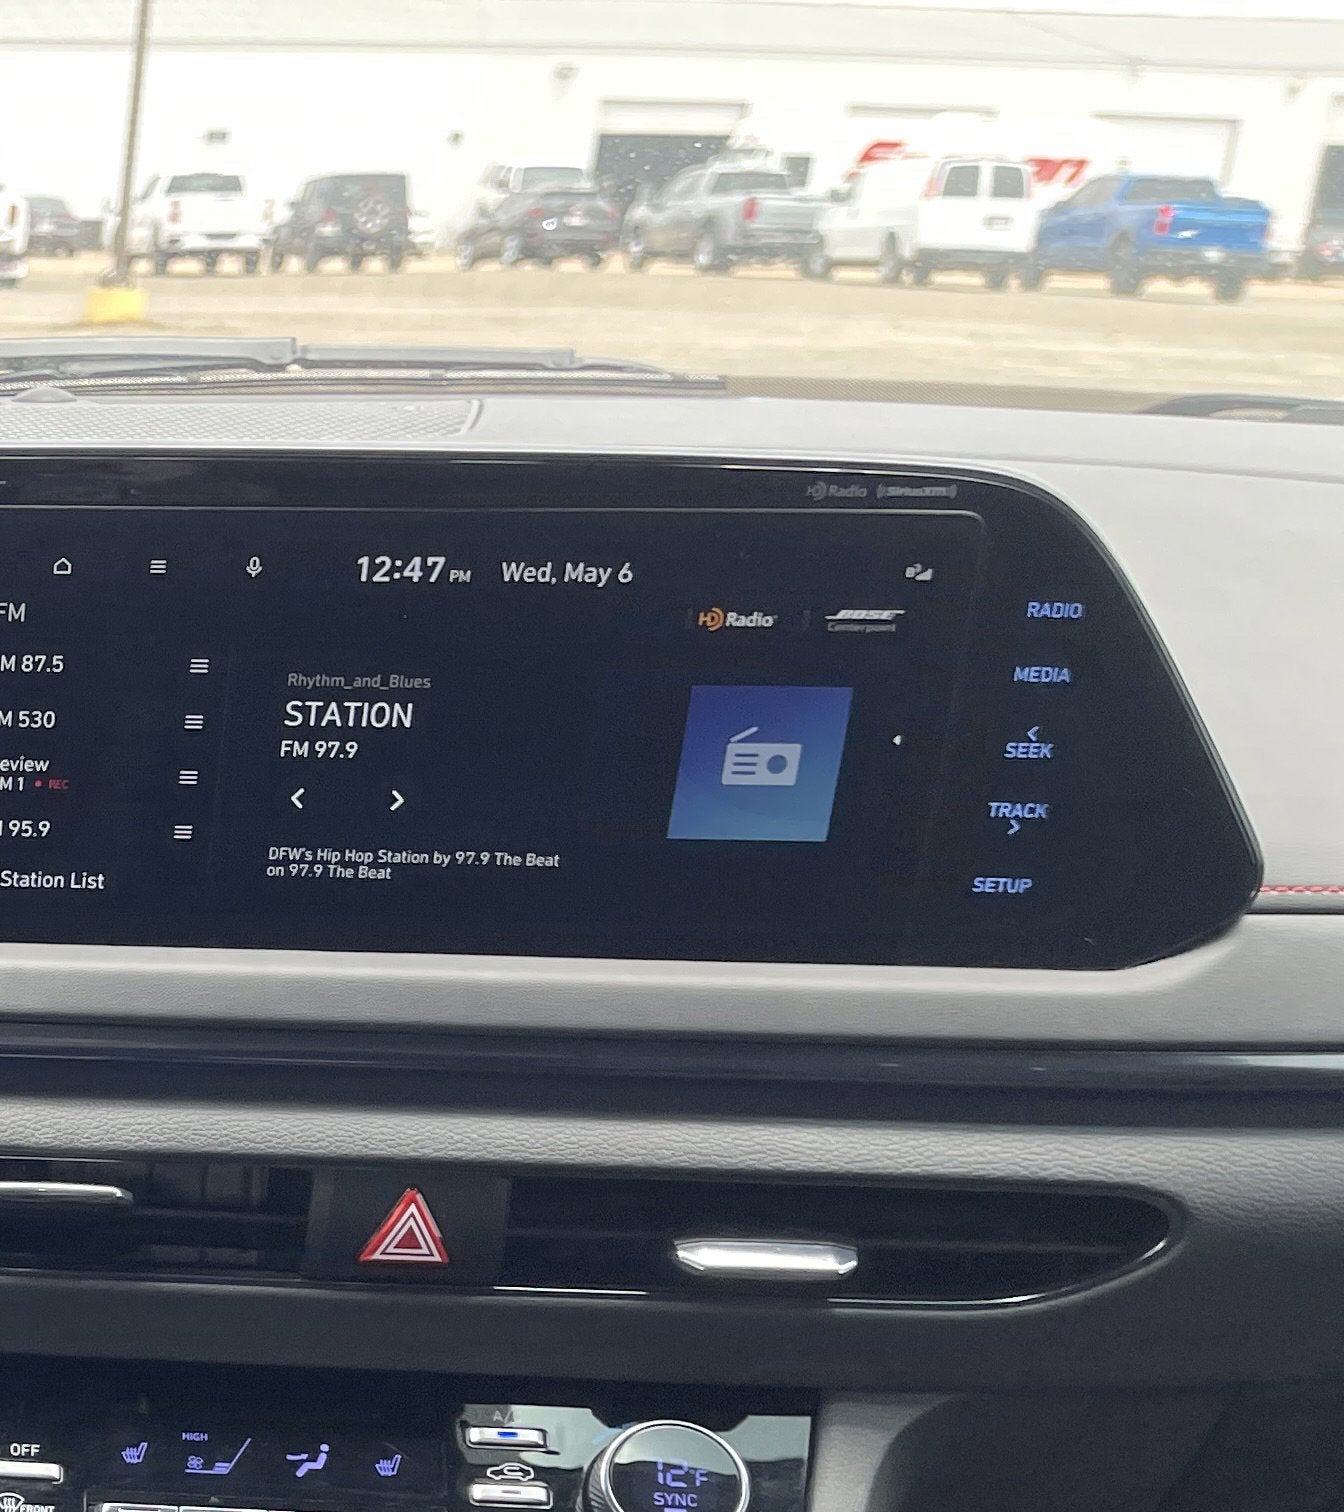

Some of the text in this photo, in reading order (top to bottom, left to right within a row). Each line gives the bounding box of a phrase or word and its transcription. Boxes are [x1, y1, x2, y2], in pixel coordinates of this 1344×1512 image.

[356, 556, 472, 584] 12:47 PM
[501, 561, 634, 588] Wed, May 6
[824, 609, 906, 621] BOSE
[1026, 602, 1083, 619] RADIO
[725, 611, 774, 628] Radio
[20, 655, 64, 674] 87.5
[287, 672, 432, 690] Rhythm_and_Blues
[1013, 666, 1071, 683] MEDIA
[17, 711, 56, 730] 530
[284, 700, 414, 729] STATION
[280, 740, 358, 760] FM 97.9
[1004, 742, 1054, 760] SEEK
[17, 776, 25, 791] 1
[988, 802, 1049, 819] TRACK
[8, 820, 51, 839] 95.9
[268, 846, 560, 868] DFW's Hip Hop Station by 97.9 The Beat
[0, 869, 105, 890] Station List
[266, 864, 392, 881] on 97.9 The Beat
[971, 877, 1033, 894] SETUP
[181, 1432, 209, 1442] HIGH
[9, 1443, 41, 1457] OFF
[653, 1491, 698, 1507] SYNC
